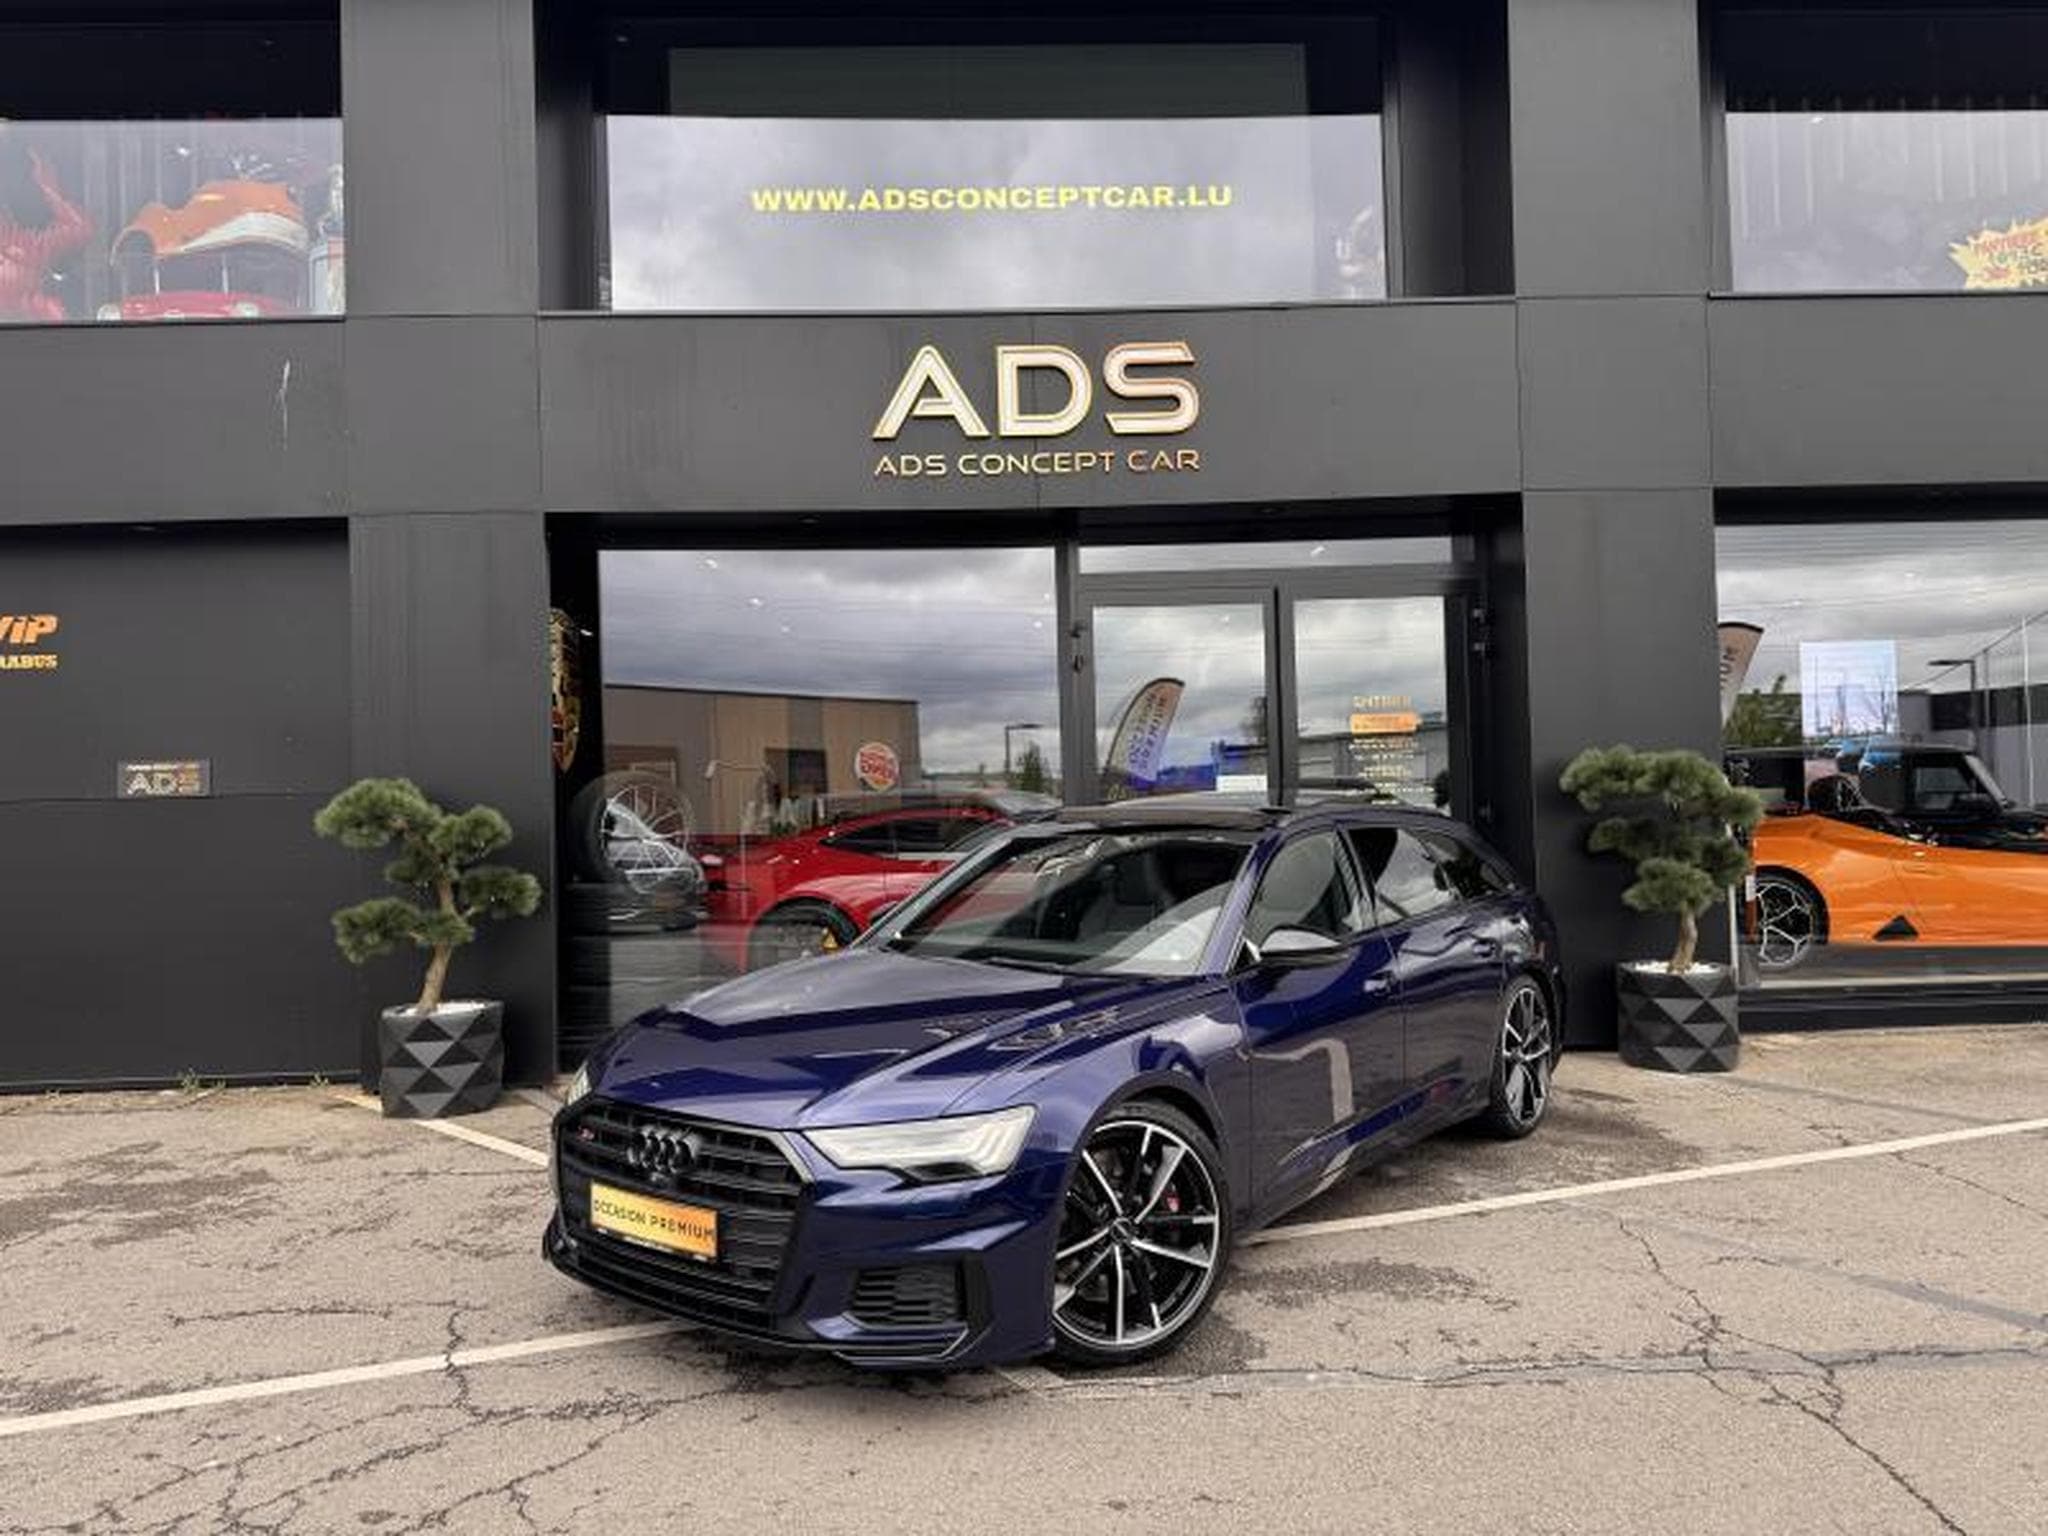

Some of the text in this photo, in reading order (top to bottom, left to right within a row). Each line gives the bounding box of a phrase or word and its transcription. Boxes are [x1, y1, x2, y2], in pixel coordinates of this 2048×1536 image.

[752, 185, 1232, 212] WWW.ADSCONCEPTCAR.LU
[872, 341, 1199, 439] ADS
[874, 450, 1201, 477] ADS CONCEPT CAR
[594, 1200, 715, 1241] OCCASION PREMIUM
